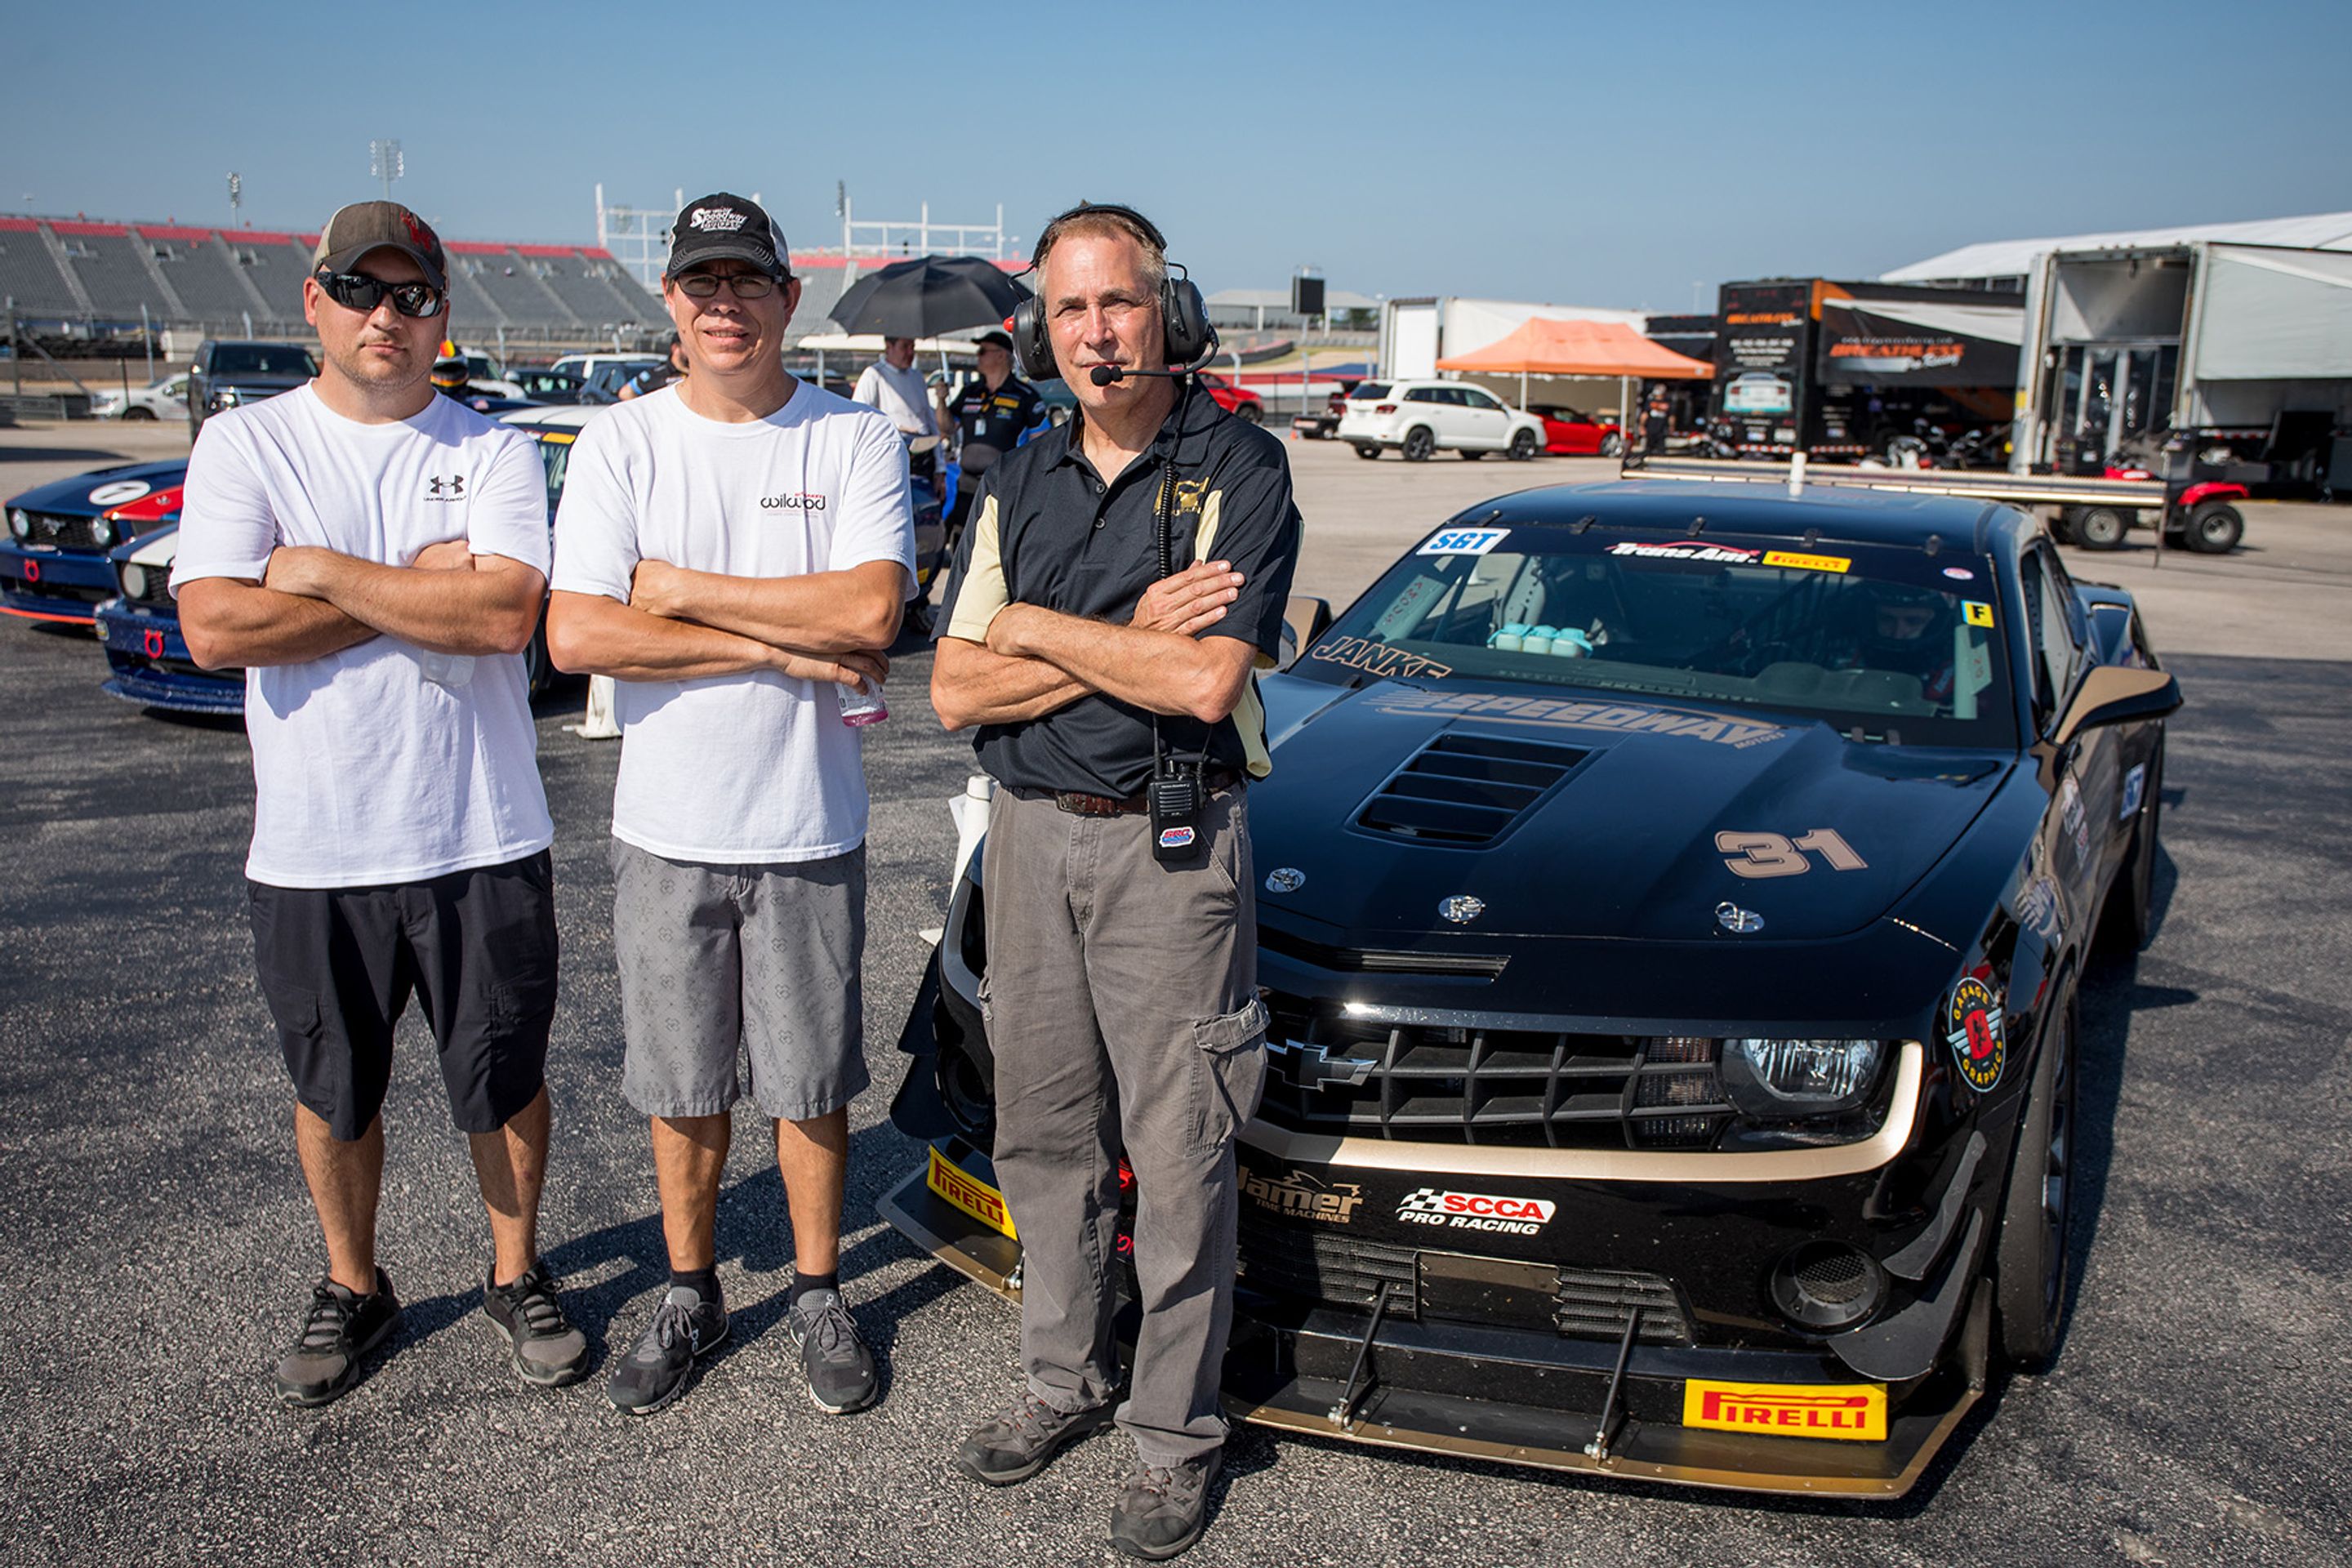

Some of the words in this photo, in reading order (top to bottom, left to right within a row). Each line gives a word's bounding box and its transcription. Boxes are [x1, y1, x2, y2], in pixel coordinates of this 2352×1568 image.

[760, 493, 826, 510] wilwod
[1611, 542, 1695, 559] Trans
[1971, 605, 1985, 620] F
[1429, 693, 1778, 745] SPEEDWAY
[1731, 731, 1787, 750] MOTORS
[1714, 828, 1869, 879] 31
[1953, 984, 1990, 1021] GARAGE
[1962, 1039, 2004, 1085] GRAPHICS
[933, 1157, 1005, 1226] PIRELLI
[1254, 1197, 1281, 1214] TIME
[1283, 1208, 1351, 1224] MACHINES
[1443, 1194, 1546, 1220] SCCA
[1398, 1211, 1446, 1226] PRO
[1449, 1216, 1541, 1236] RACING
[1701, 1390, 1869, 1429] PIRELLI
